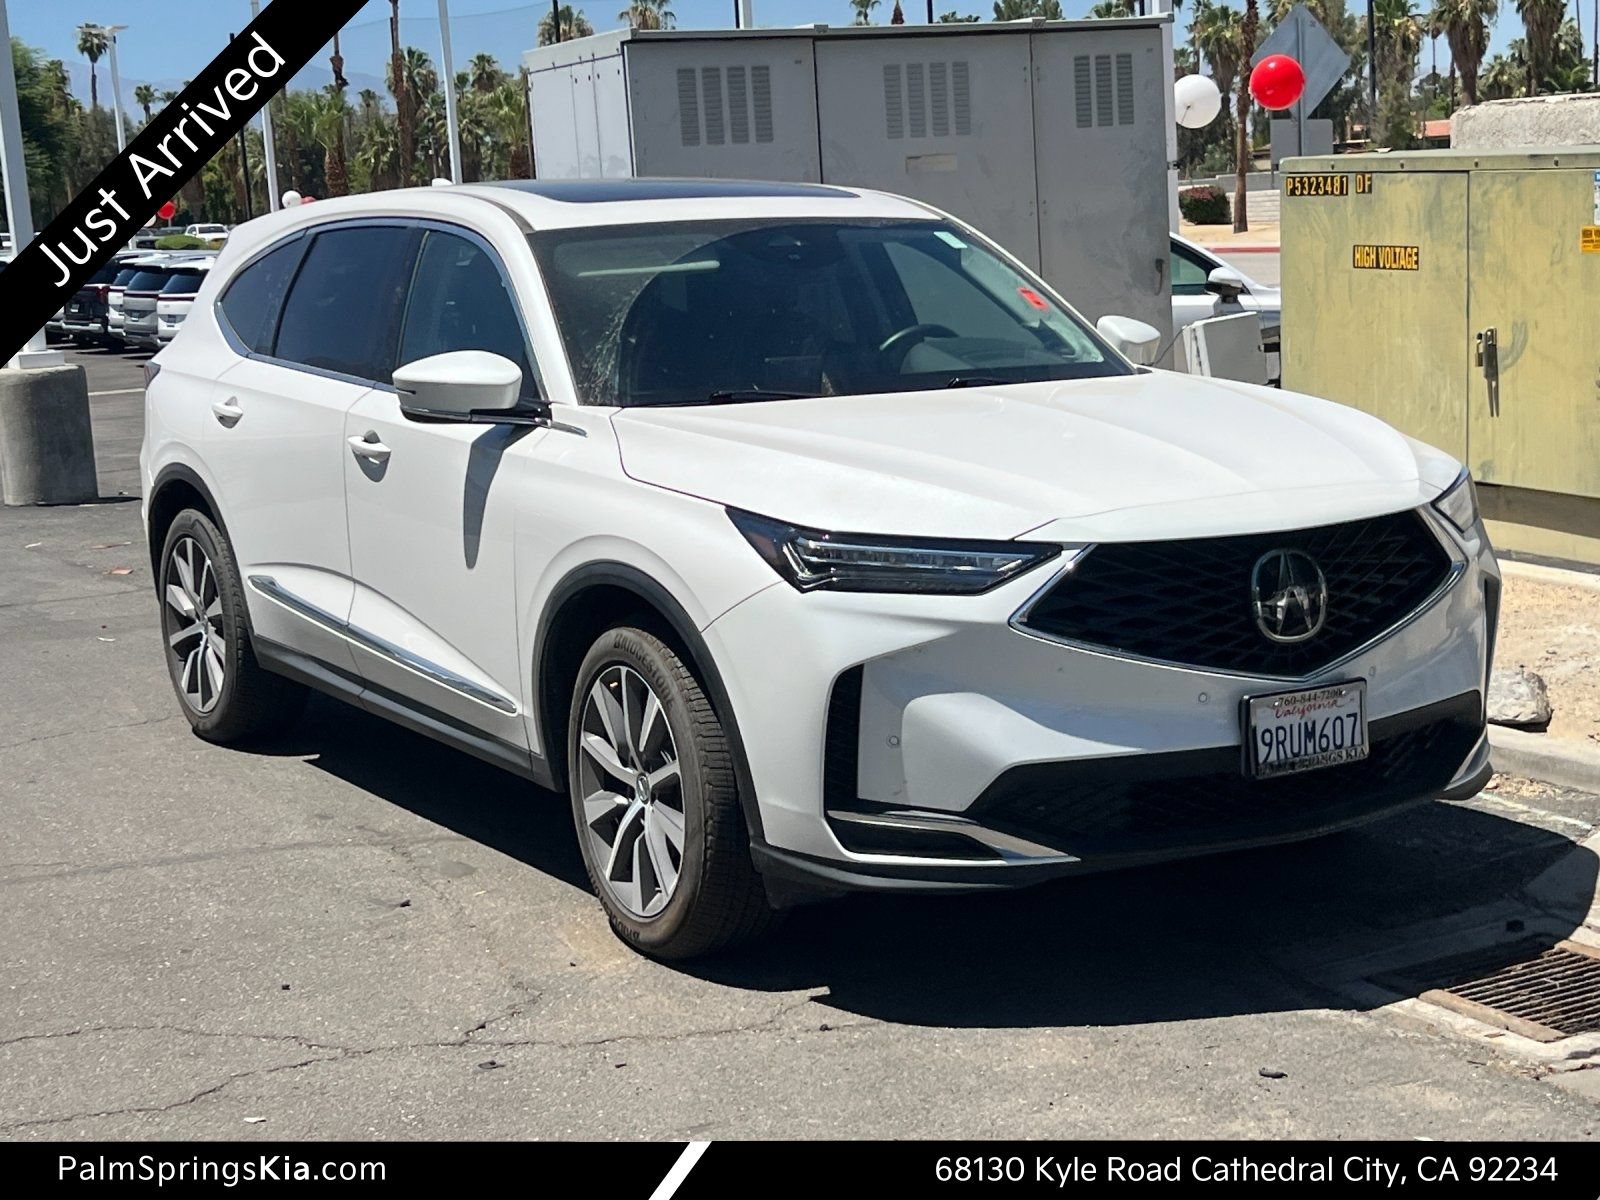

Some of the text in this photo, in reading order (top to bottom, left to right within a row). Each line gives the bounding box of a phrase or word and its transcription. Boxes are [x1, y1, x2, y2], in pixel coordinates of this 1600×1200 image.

[1287, 176, 1347, 195] P5323481
[1354, 246, 1418, 269] HIGH VOLTAGE
[1275, 699, 1344, 719] California
[1260, 712, 1358, 765] 9RUM607
[1346, 746, 1366, 761] KIA
